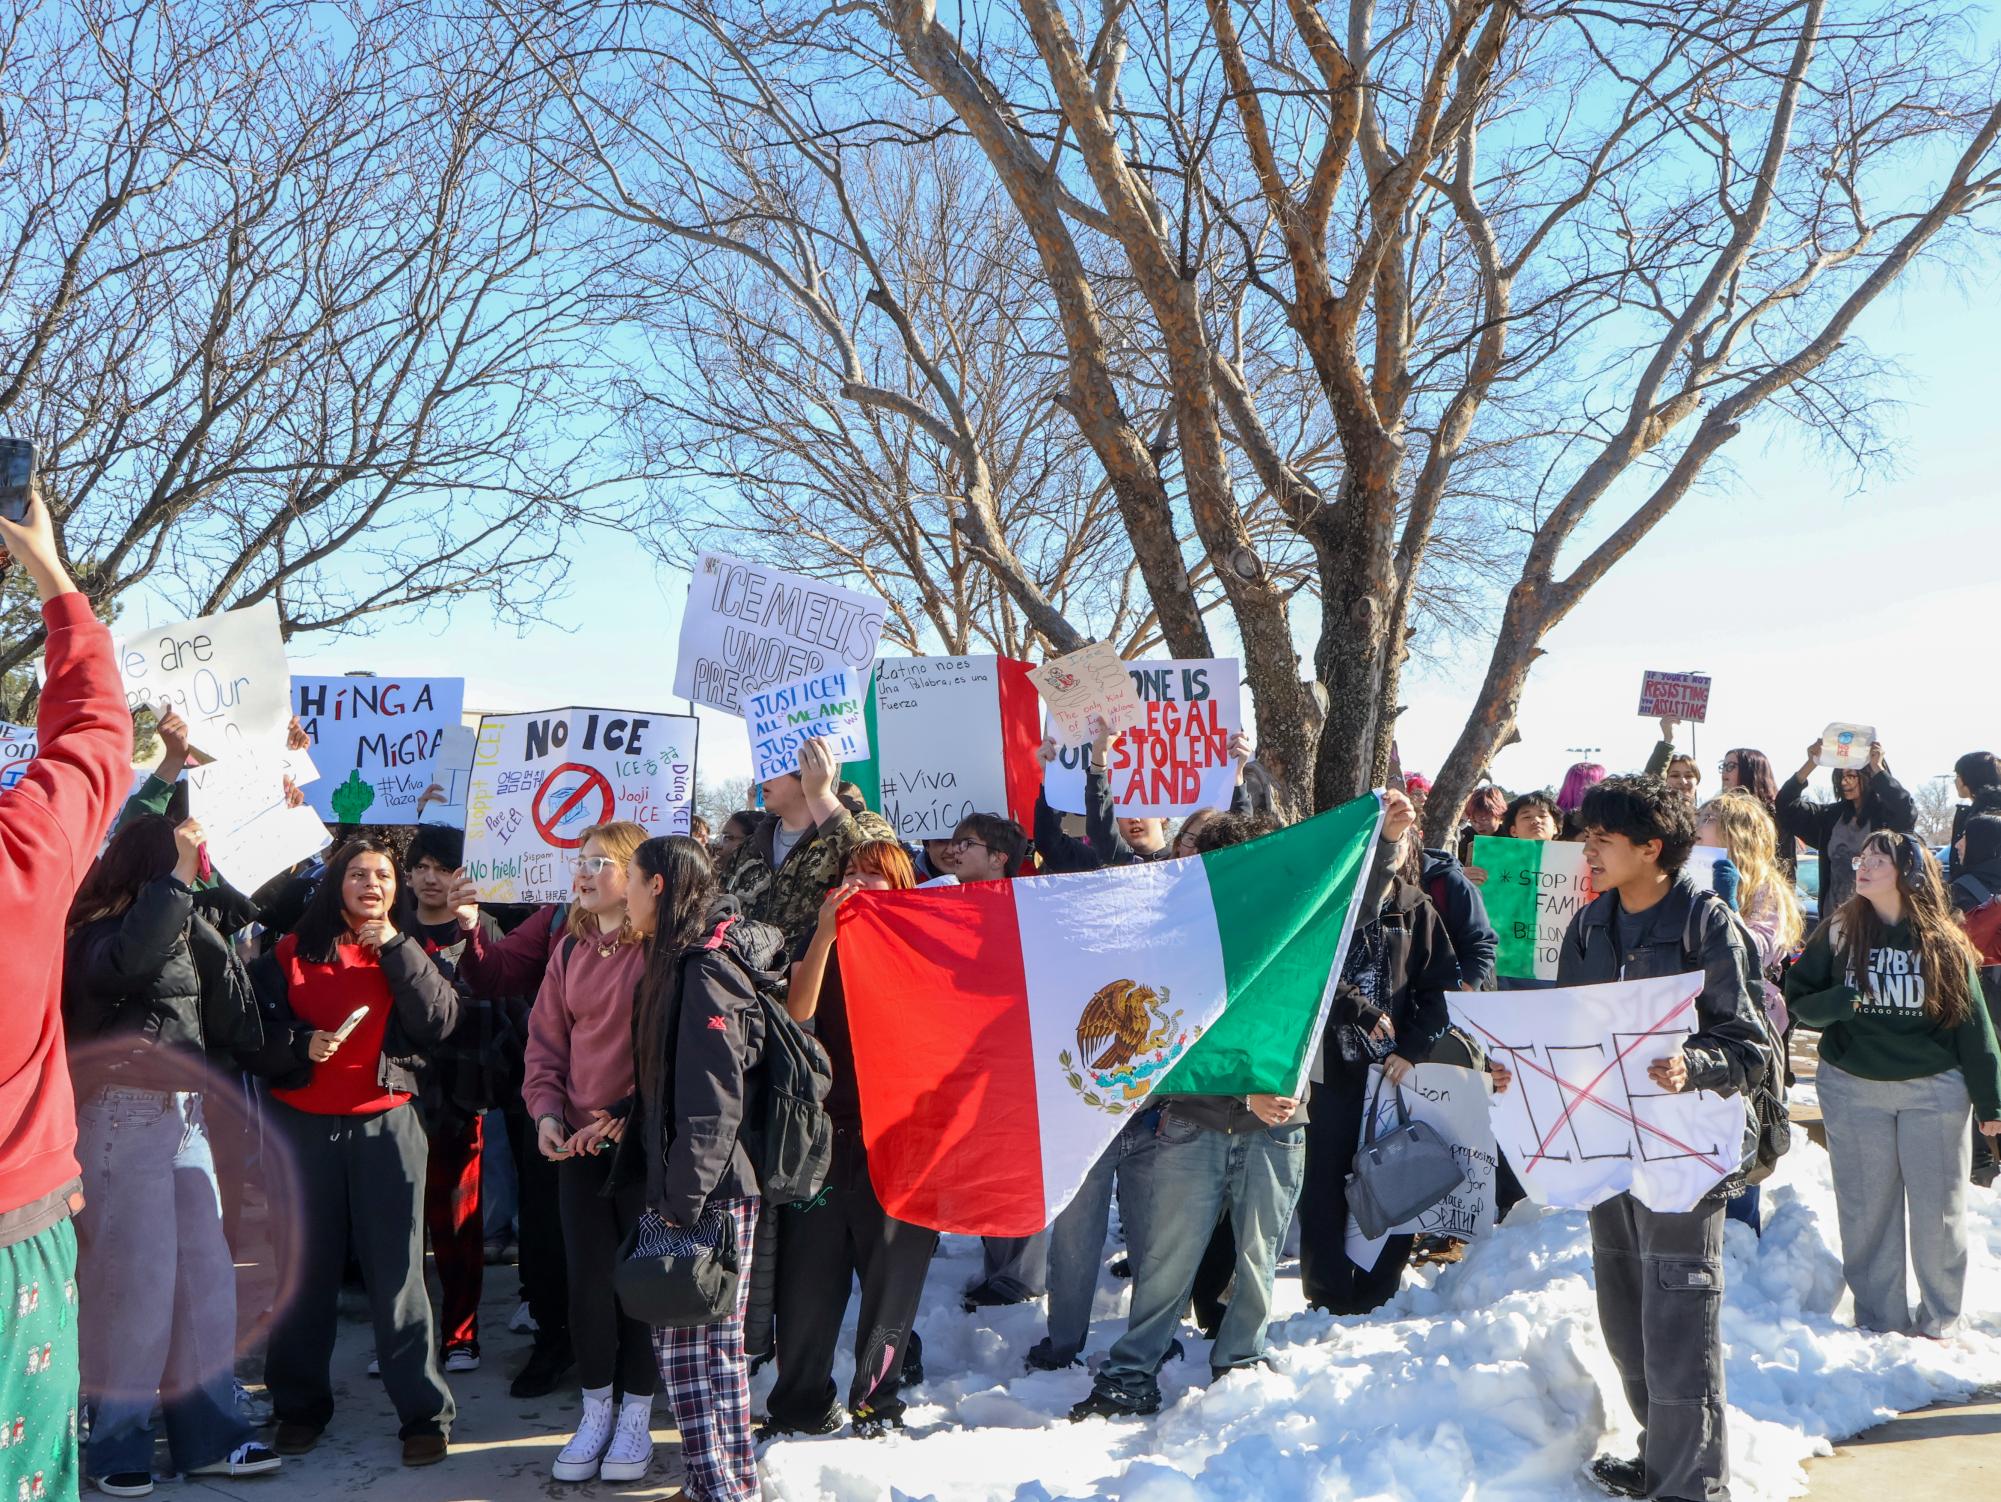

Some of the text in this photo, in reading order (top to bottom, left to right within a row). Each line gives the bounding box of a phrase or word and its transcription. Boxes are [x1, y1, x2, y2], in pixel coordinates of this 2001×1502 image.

[712, 563, 883, 671] ICE MELTS
[160, 635, 213, 671] are
[876, 658, 927, 682] Latino
[1647, 671, 1657, 680] IF
[1692, 676, 1710, 685] NOT
[194, 668, 249, 714] Our
[879, 682, 900, 695] Una
[1181, 668, 1210, 702] IS
[1644, 680, 1710, 702] RESISTING
[879, 697, 918, 710] Fuerza
[1056, 710, 1079, 722] The
[1083, 701, 1103, 713] only
[1651, 698, 1706, 720] ASSISTING
[756, 719, 782, 737] ALL
[787, 699, 859, 728] MEANS!
[524, 715, 650, 762] NO ICE
[756, 721, 841, 760] JUSTICE
[1111, 734, 1228, 770] STOLEN
[616, 761, 641, 778] ICE
[760, 751, 798, 779] FOR
[377, 774, 423, 793] #Viva
[618, 784, 649, 804] Jooji
[881, 769, 957, 798] #Viva
[1108, 768, 1201, 805] AND
[380, 792, 417, 808] Raza
[633, 806, 660, 823] ICE
[525, 863, 552, 887] ICE!
[1519, 869, 1567, 890] STOP
[1487, 1026, 1719, 1162] ICE
[1465, 1168, 1486, 1193] for
[1417, 1207, 1476, 1234] DEATH!
